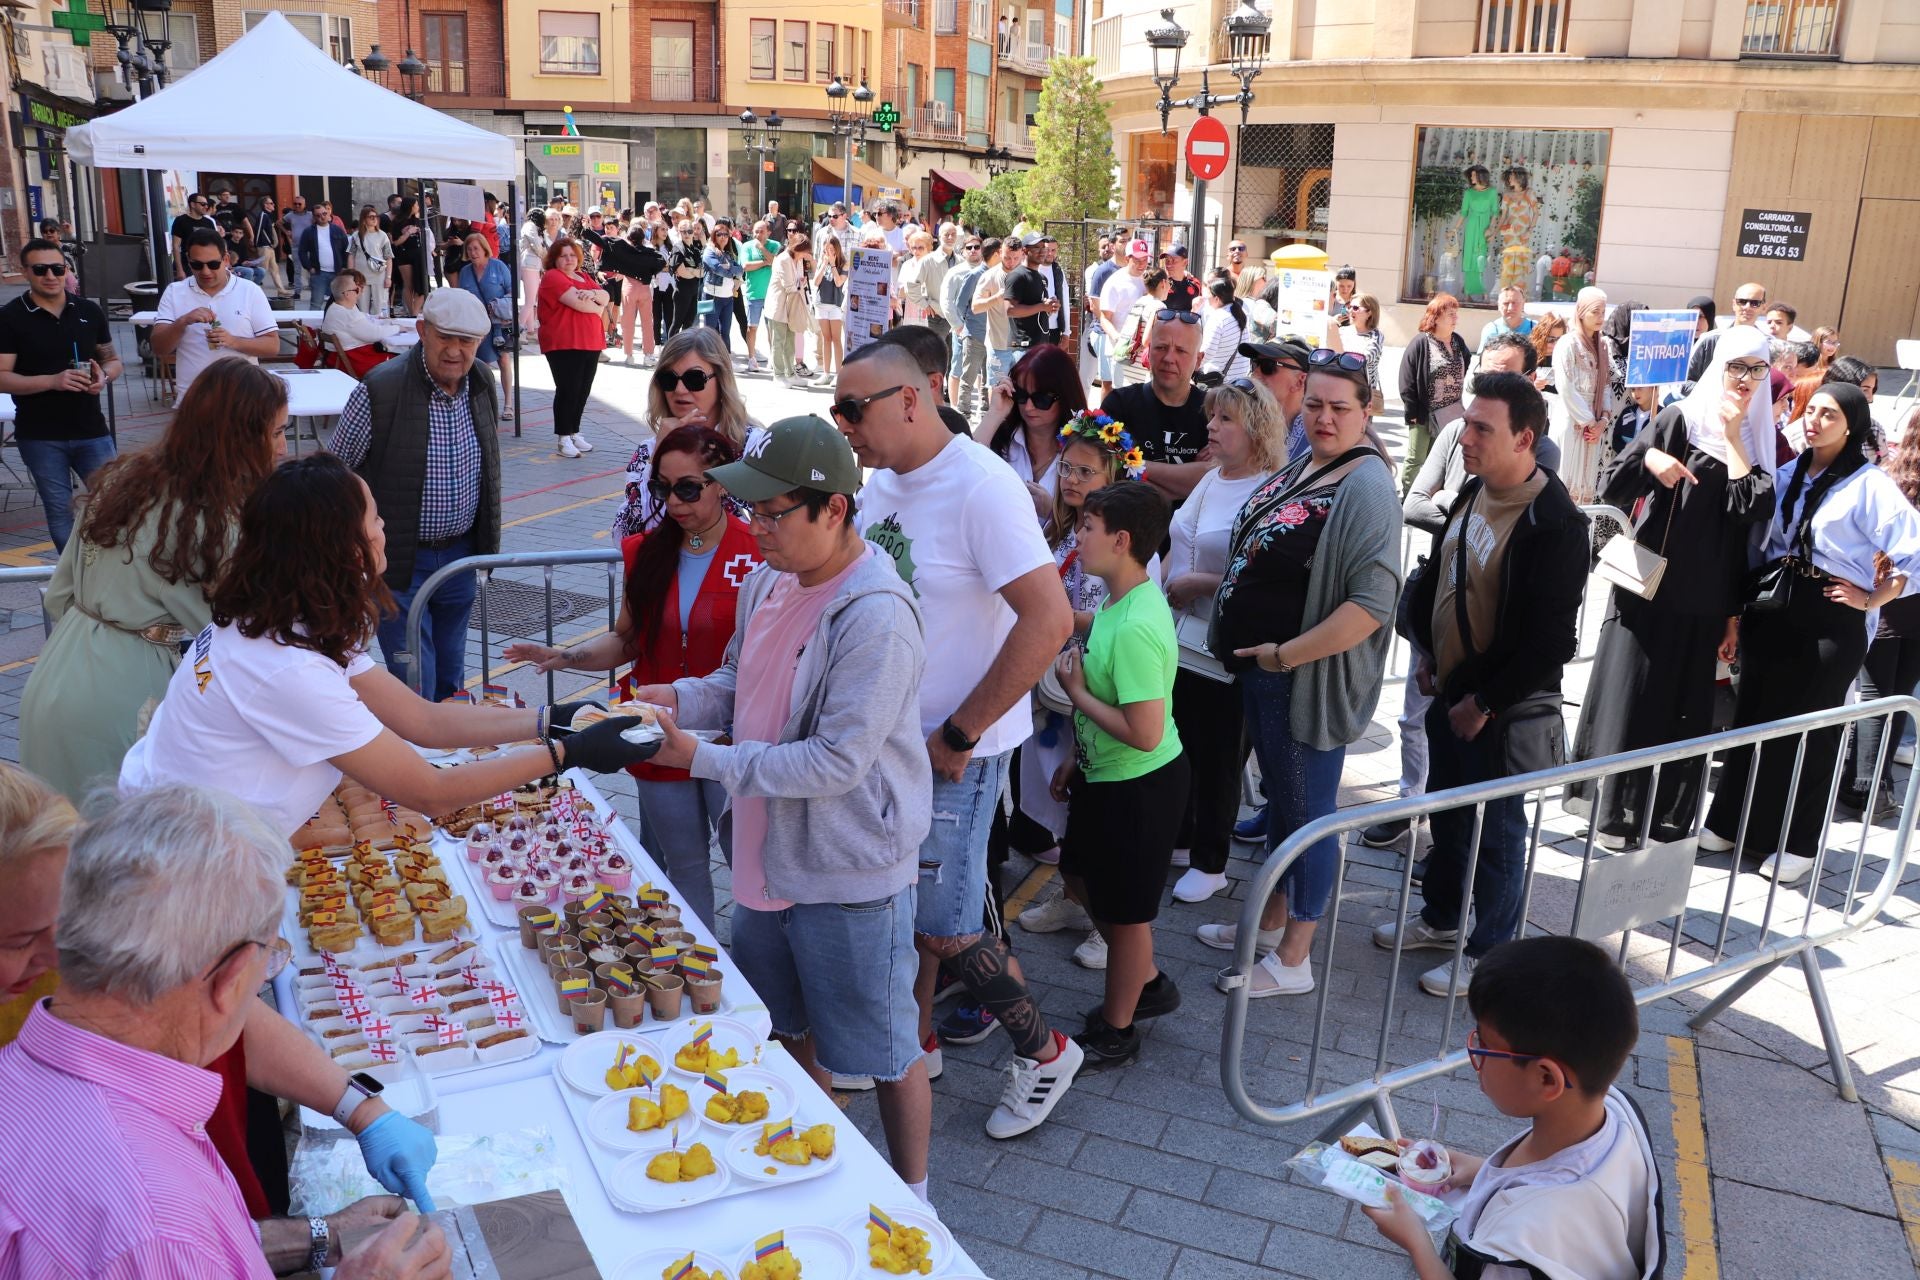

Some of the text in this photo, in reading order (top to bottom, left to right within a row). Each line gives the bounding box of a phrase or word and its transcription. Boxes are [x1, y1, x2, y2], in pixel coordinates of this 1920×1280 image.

[875, 113, 897, 122] 12:01
[553, 145, 577, 154] ONCE
[600, 164, 617, 173] ONCE
[1758, 212, 1795, 222] CARRANZA
[1744, 222, 1805, 233] CONSULTORIA, S.L.
[1759, 234, 1788, 244] VENDE
[1743, 244, 1799, 258] 687 95 43 53
[1636, 344, 1685, 360] ENTRADA
[879, 511, 901, 533] the
